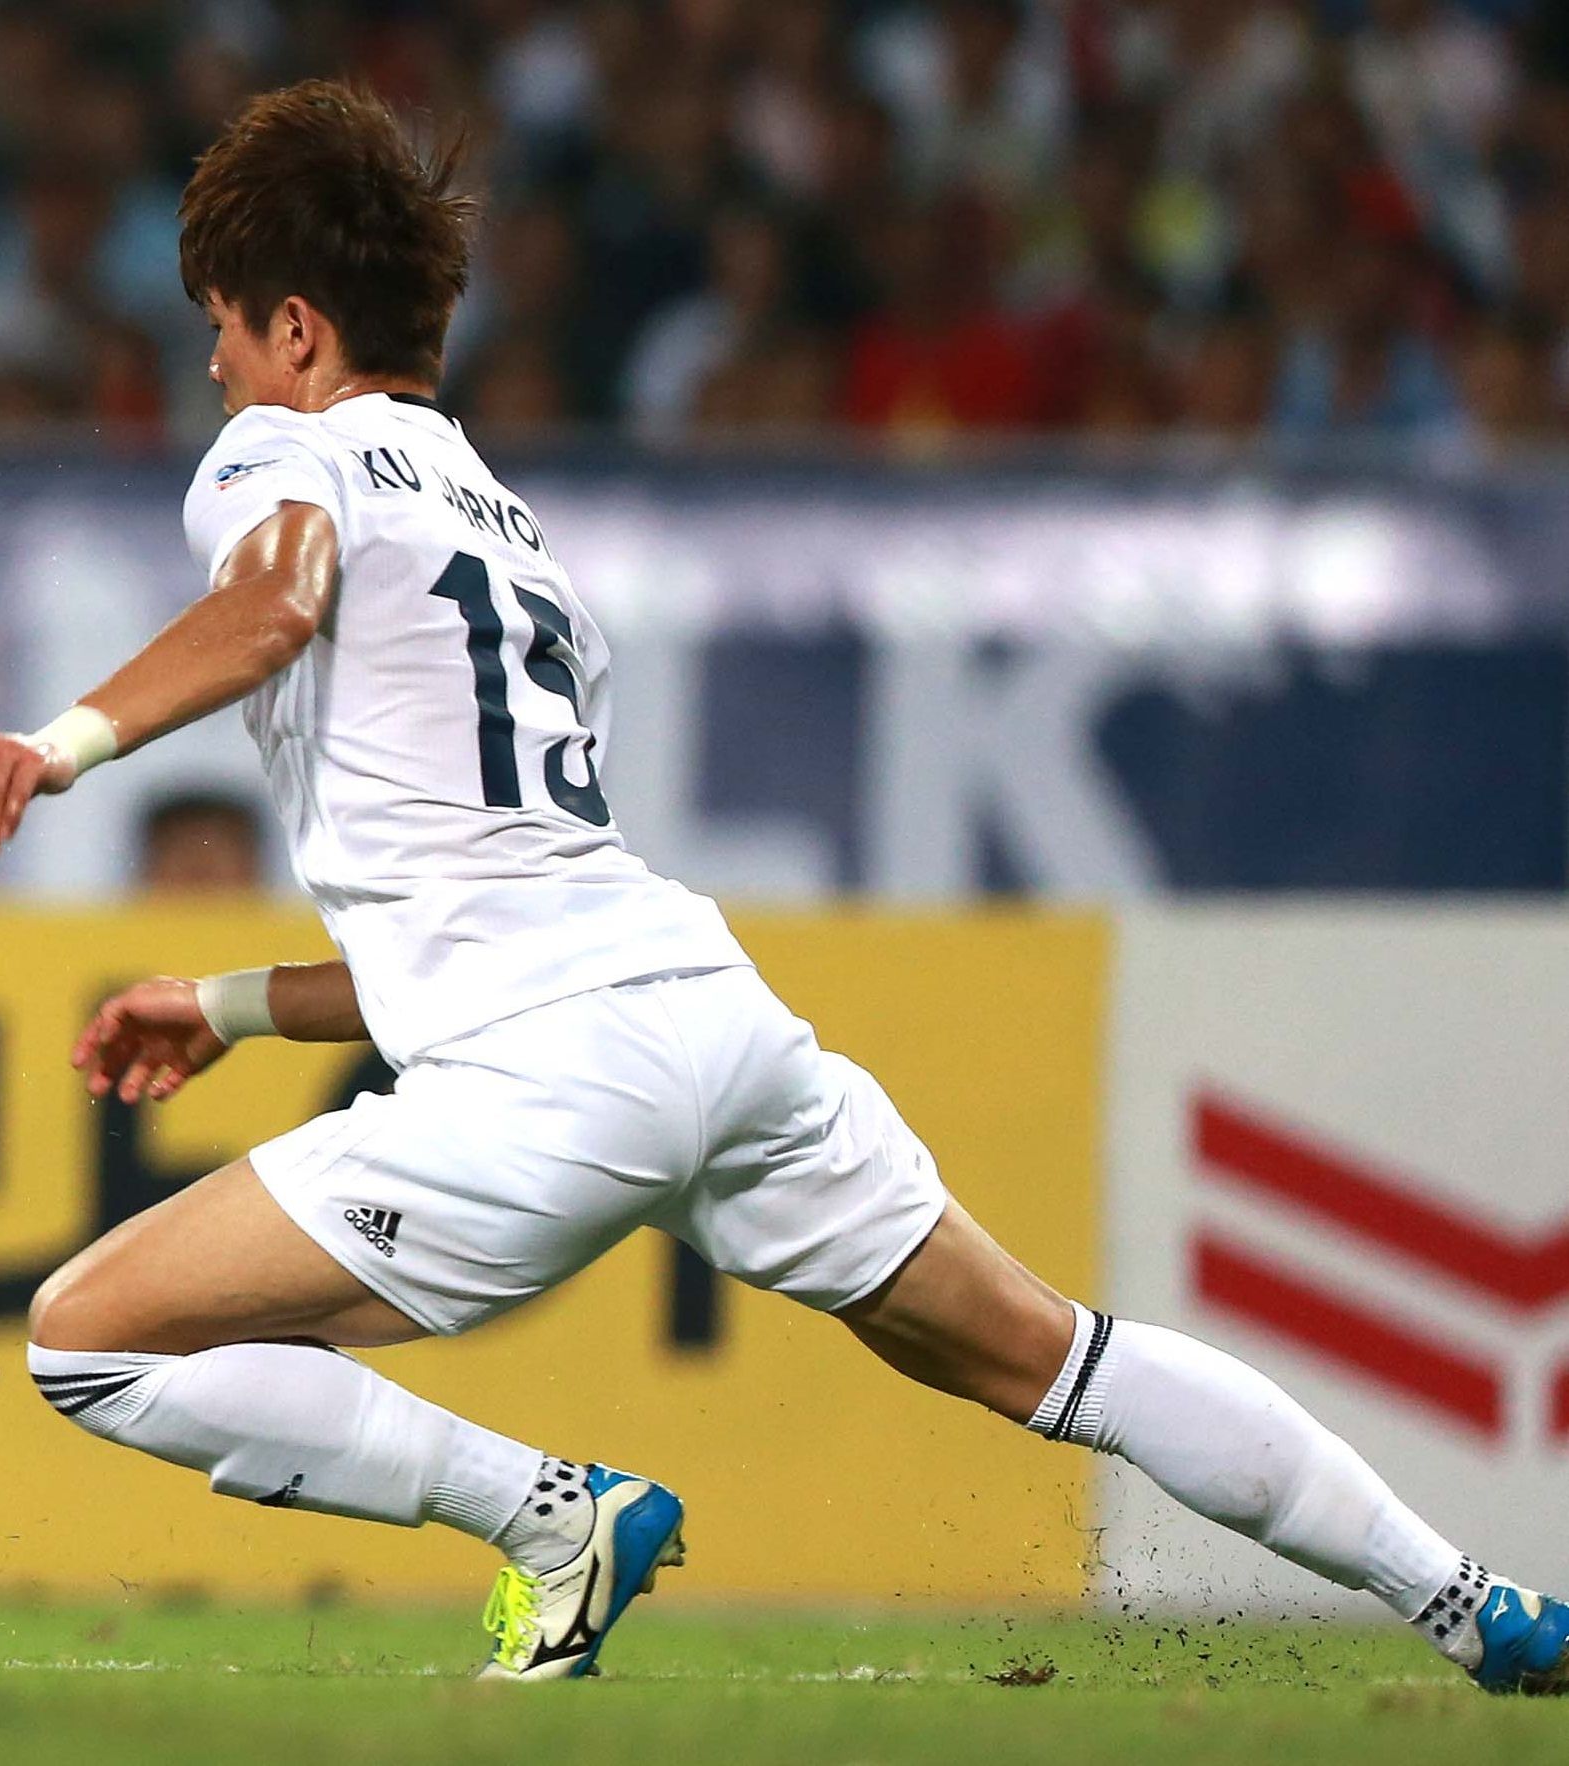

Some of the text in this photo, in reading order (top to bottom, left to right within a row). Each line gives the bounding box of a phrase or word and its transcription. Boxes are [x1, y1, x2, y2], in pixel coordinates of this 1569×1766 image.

[349, 446, 553, 562] KU JARYO
[428, 550, 612, 827] 15
[343, 1207, 397, 1258] adidas
